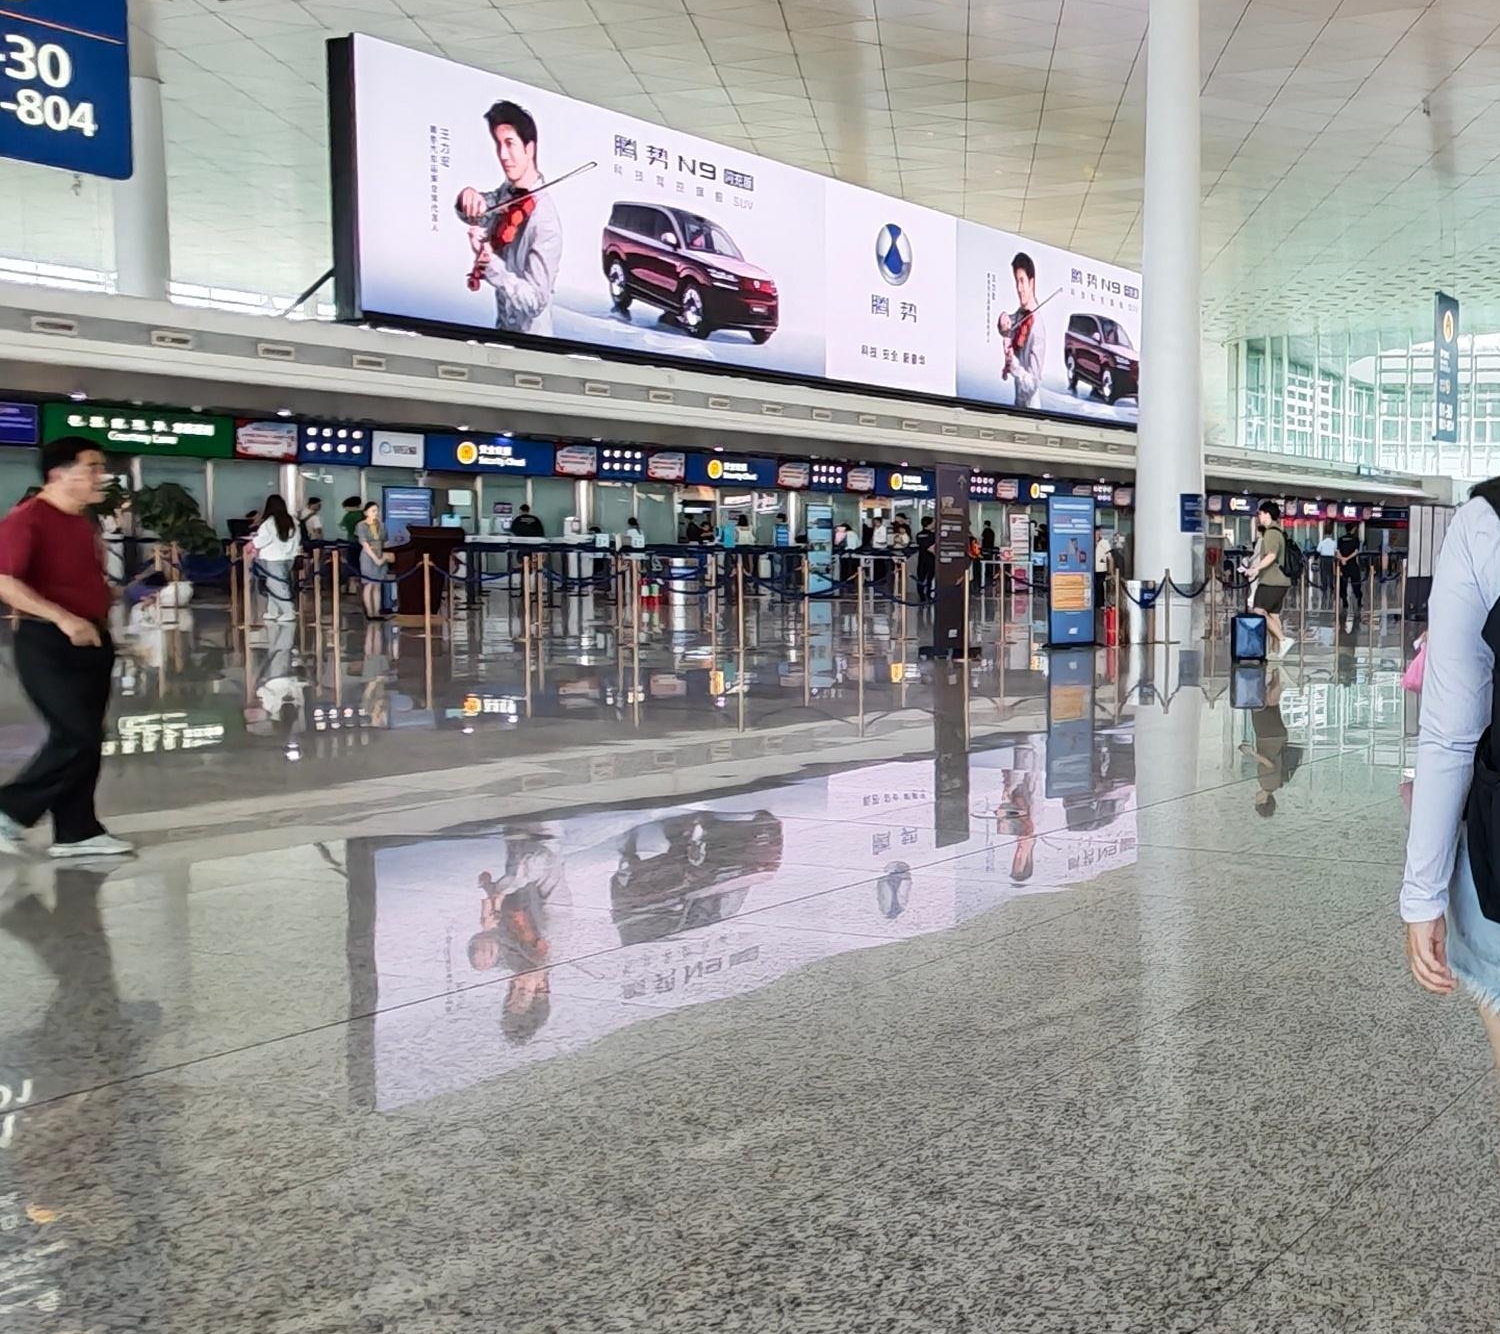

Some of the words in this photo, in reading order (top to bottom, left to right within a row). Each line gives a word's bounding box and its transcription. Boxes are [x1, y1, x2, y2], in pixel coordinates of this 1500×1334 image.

[0, 88, 98, 137] -804
[614, 134, 669, 171] 腾势
[678, 155, 717, 181] N9
[1101, 278, 1121, 295] N9
[871, 293, 918, 324] 腾势
